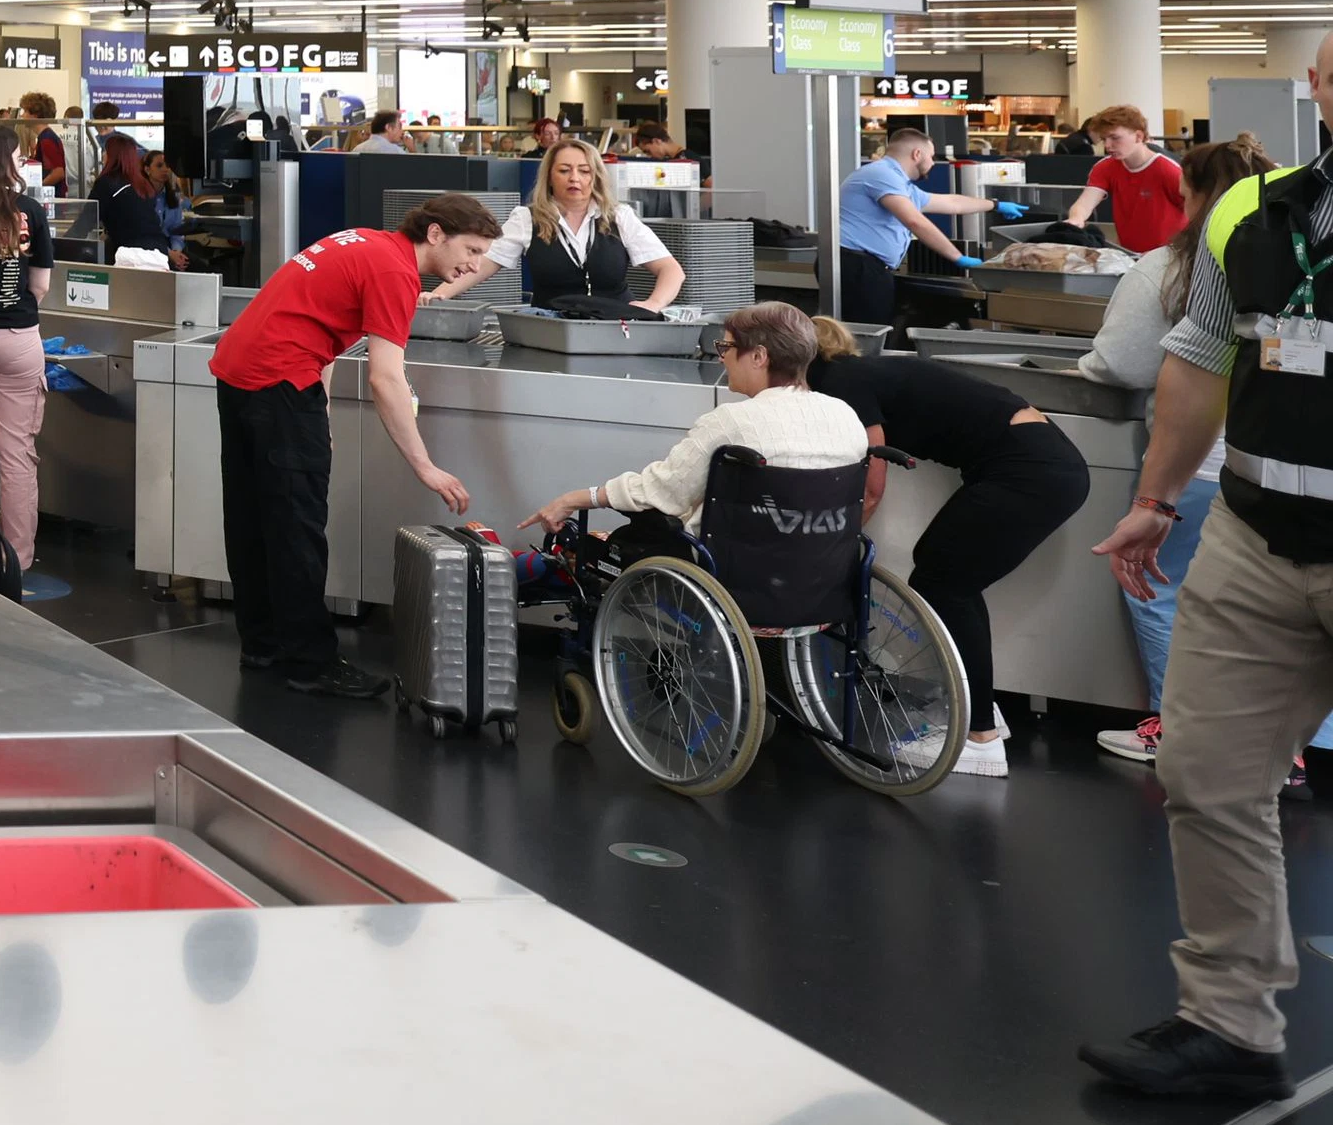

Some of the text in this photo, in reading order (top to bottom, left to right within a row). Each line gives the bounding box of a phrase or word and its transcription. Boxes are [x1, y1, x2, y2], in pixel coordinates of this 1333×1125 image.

[790, 14, 829, 35] Economy
[838, 17, 878, 38] Economy
[774, 23, 784, 53] 5
[791, 34, 812, 51] Class
[839, 37, 861, 52] Class
[883, 28, 894, 58] 6
[88, 41, 114, 61] This
[117, 42, 127, 62] is
[89, 66, 98, 75] This
[112, 69, 122, 78] way
[122, 68, 127, 76] of
